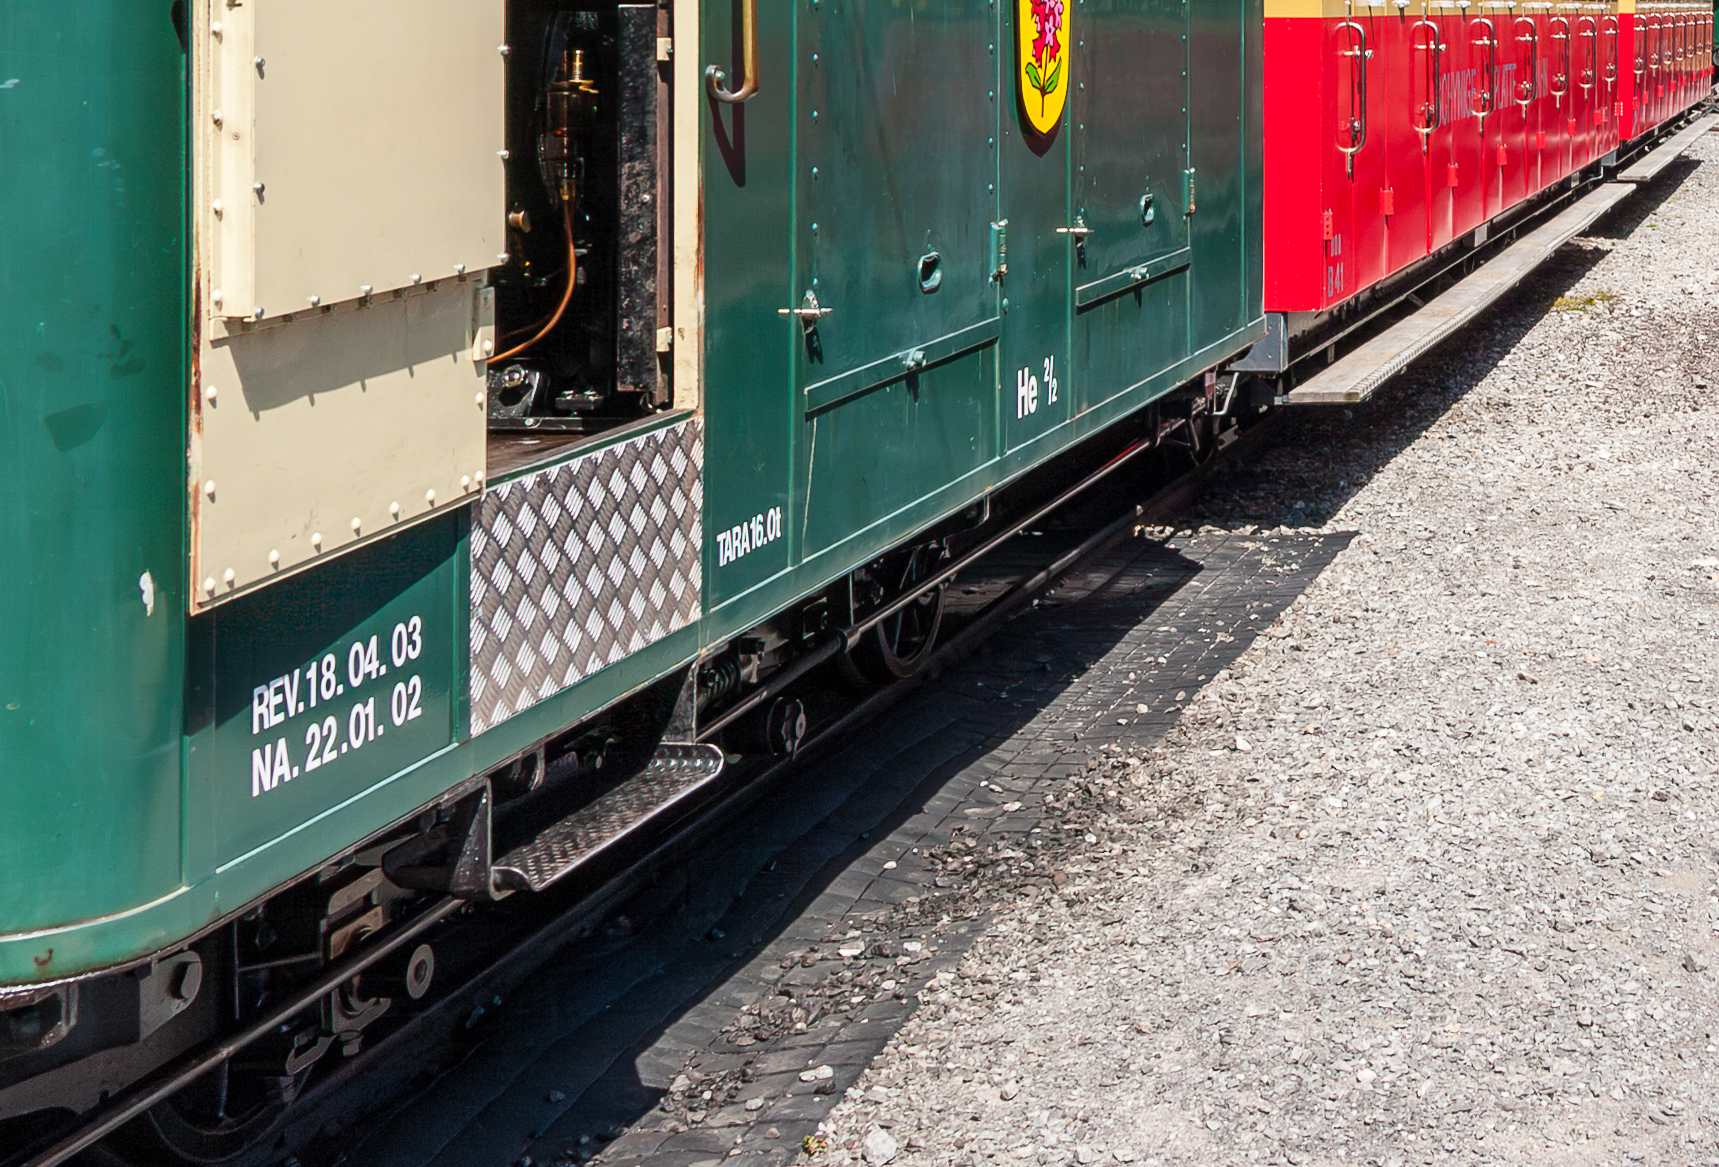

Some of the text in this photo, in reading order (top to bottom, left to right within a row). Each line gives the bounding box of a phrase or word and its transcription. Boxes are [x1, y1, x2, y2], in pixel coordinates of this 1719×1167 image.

[1017, 366, 1038, 420] He
[391, 615, 422, 668] 03
[252, 737, 300, 798] NA.
[391, 674, 422, 727] 02
